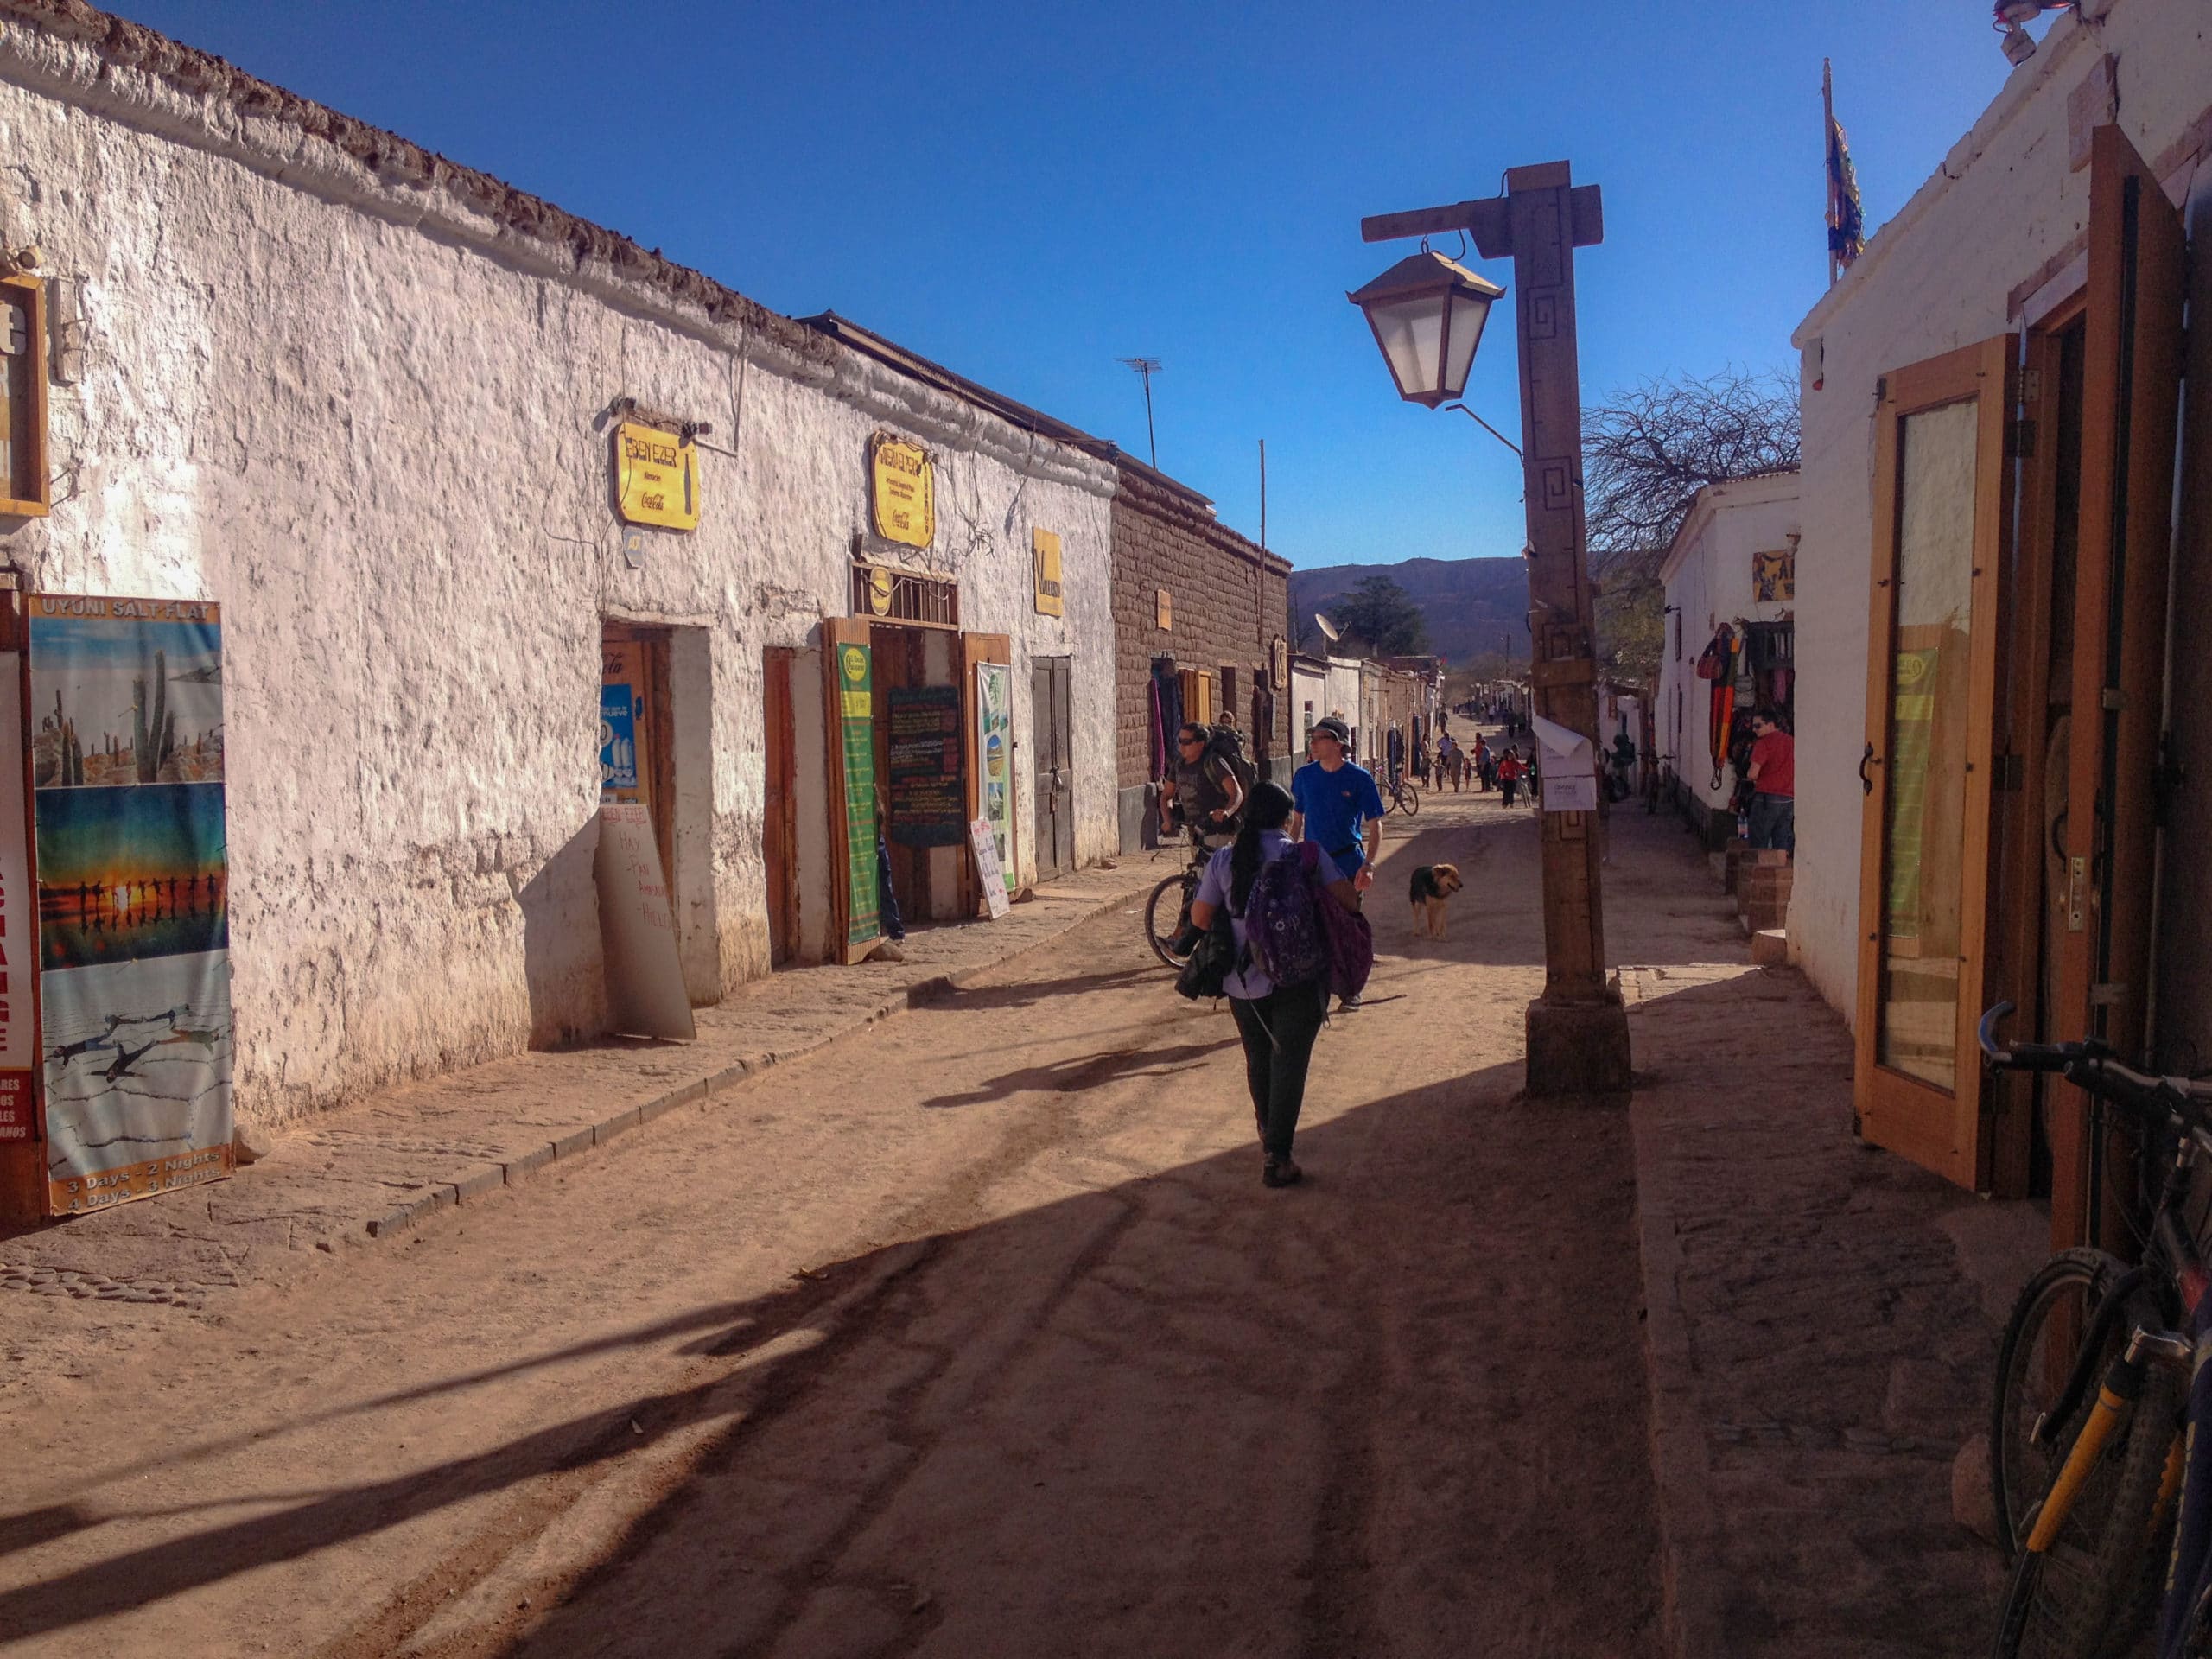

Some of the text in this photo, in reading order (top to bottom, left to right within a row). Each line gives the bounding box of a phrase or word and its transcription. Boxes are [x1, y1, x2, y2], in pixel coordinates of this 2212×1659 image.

[652, 443, 677, 468] EZER
[43, 598, 209, 620] UYUNI SALT FLAT
[68, 1181, 79, 1193] 3
[87, 1172, 130, 1190] Days
[149, 1163, 158, 1175] 2
[165, 1152, 220, 1172] Nights
[68, 1198, 80, 1211] 4
[88, 1189, 130, 1207] Days
[148, 1180, 159, 1192] 3
[165, 1169, 221, 1189] Nights
